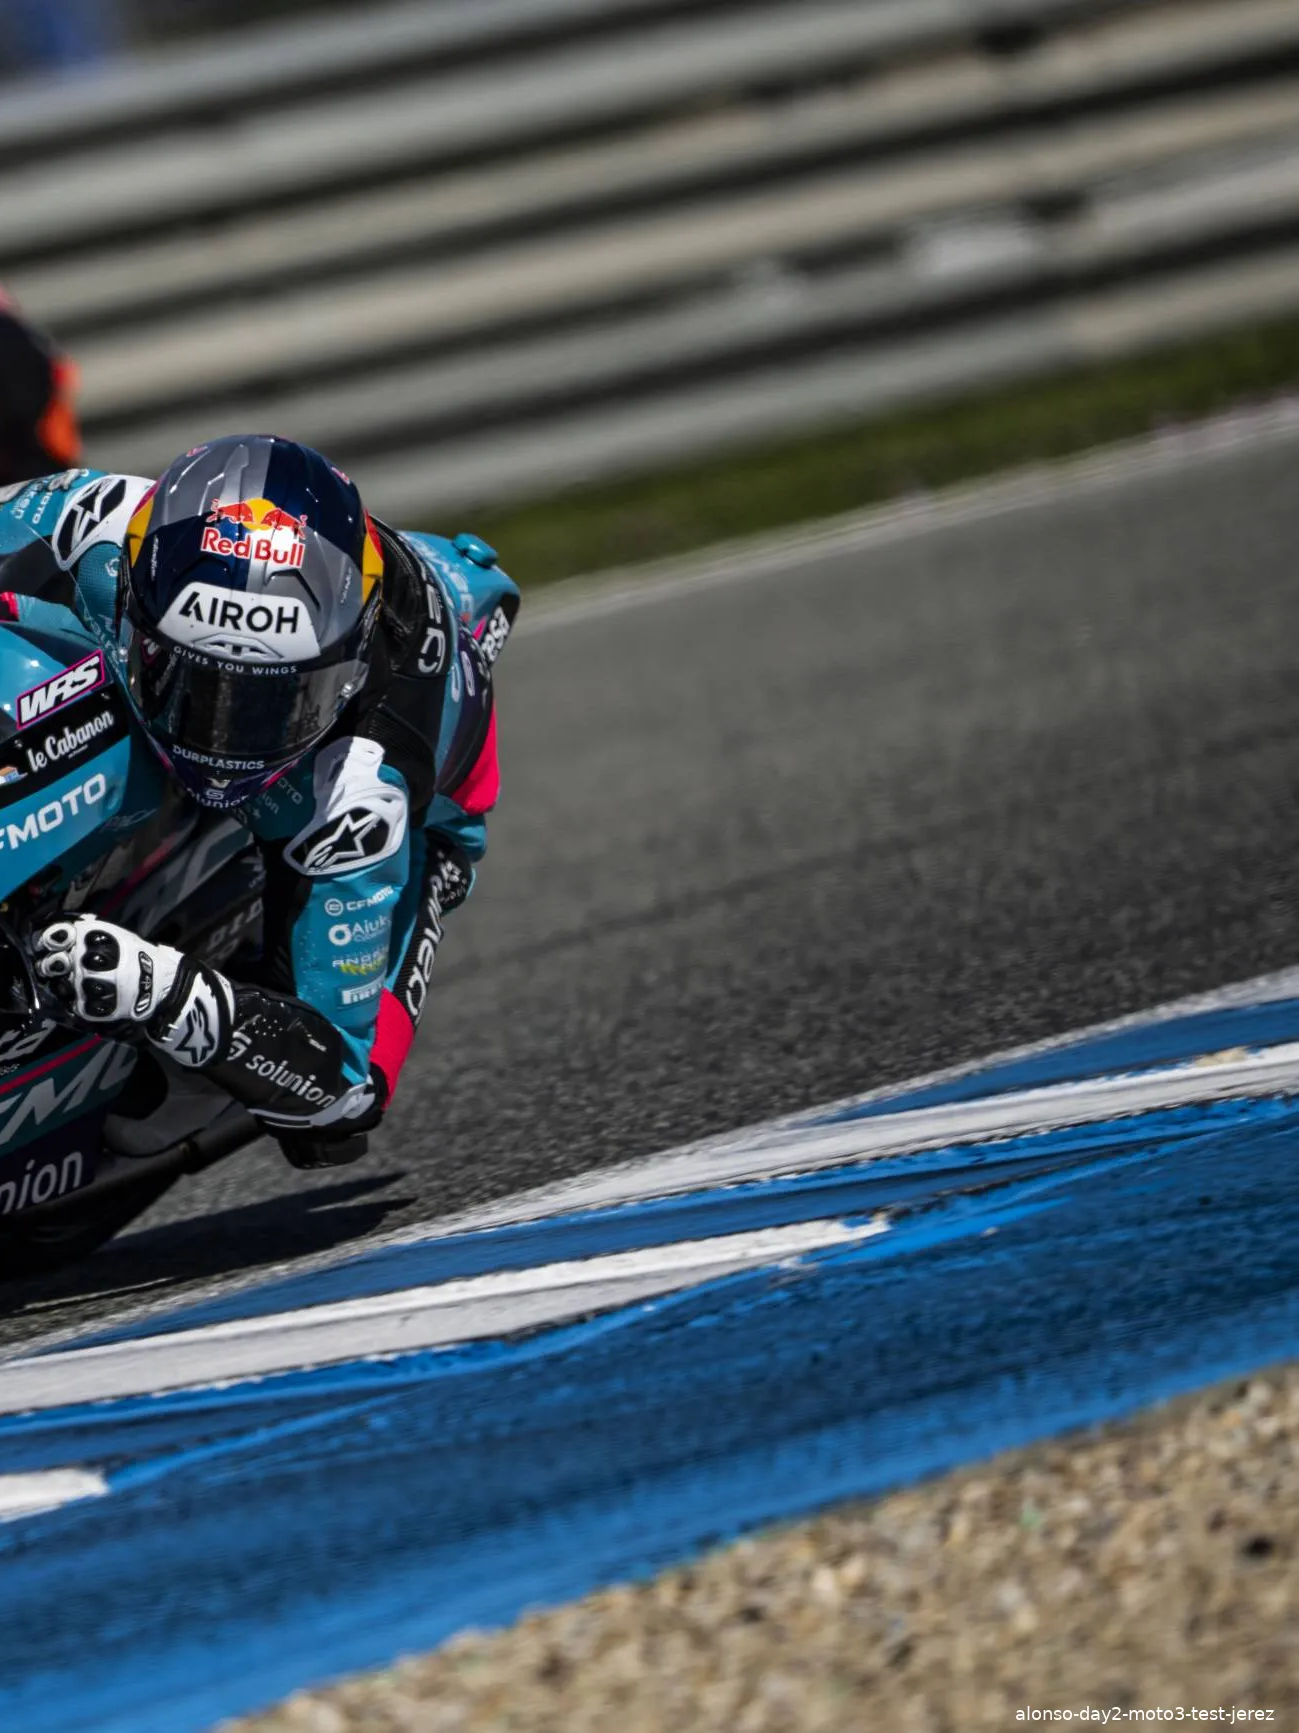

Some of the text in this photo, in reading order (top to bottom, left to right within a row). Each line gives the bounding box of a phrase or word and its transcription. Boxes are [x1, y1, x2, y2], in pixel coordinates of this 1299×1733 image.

[201, 527, 305, 568] Red Bull
[179, 591, 299, 634] AIROH
[173, 646, 298, 675] GIVES YOU WINGS
[20, 656, 100, 723] WRS
[26, 710, 114, 772] le Cabanon
[172, 744, 265, 770] DURPLASTICS
[245, 1055, 336, 1108] solunion
